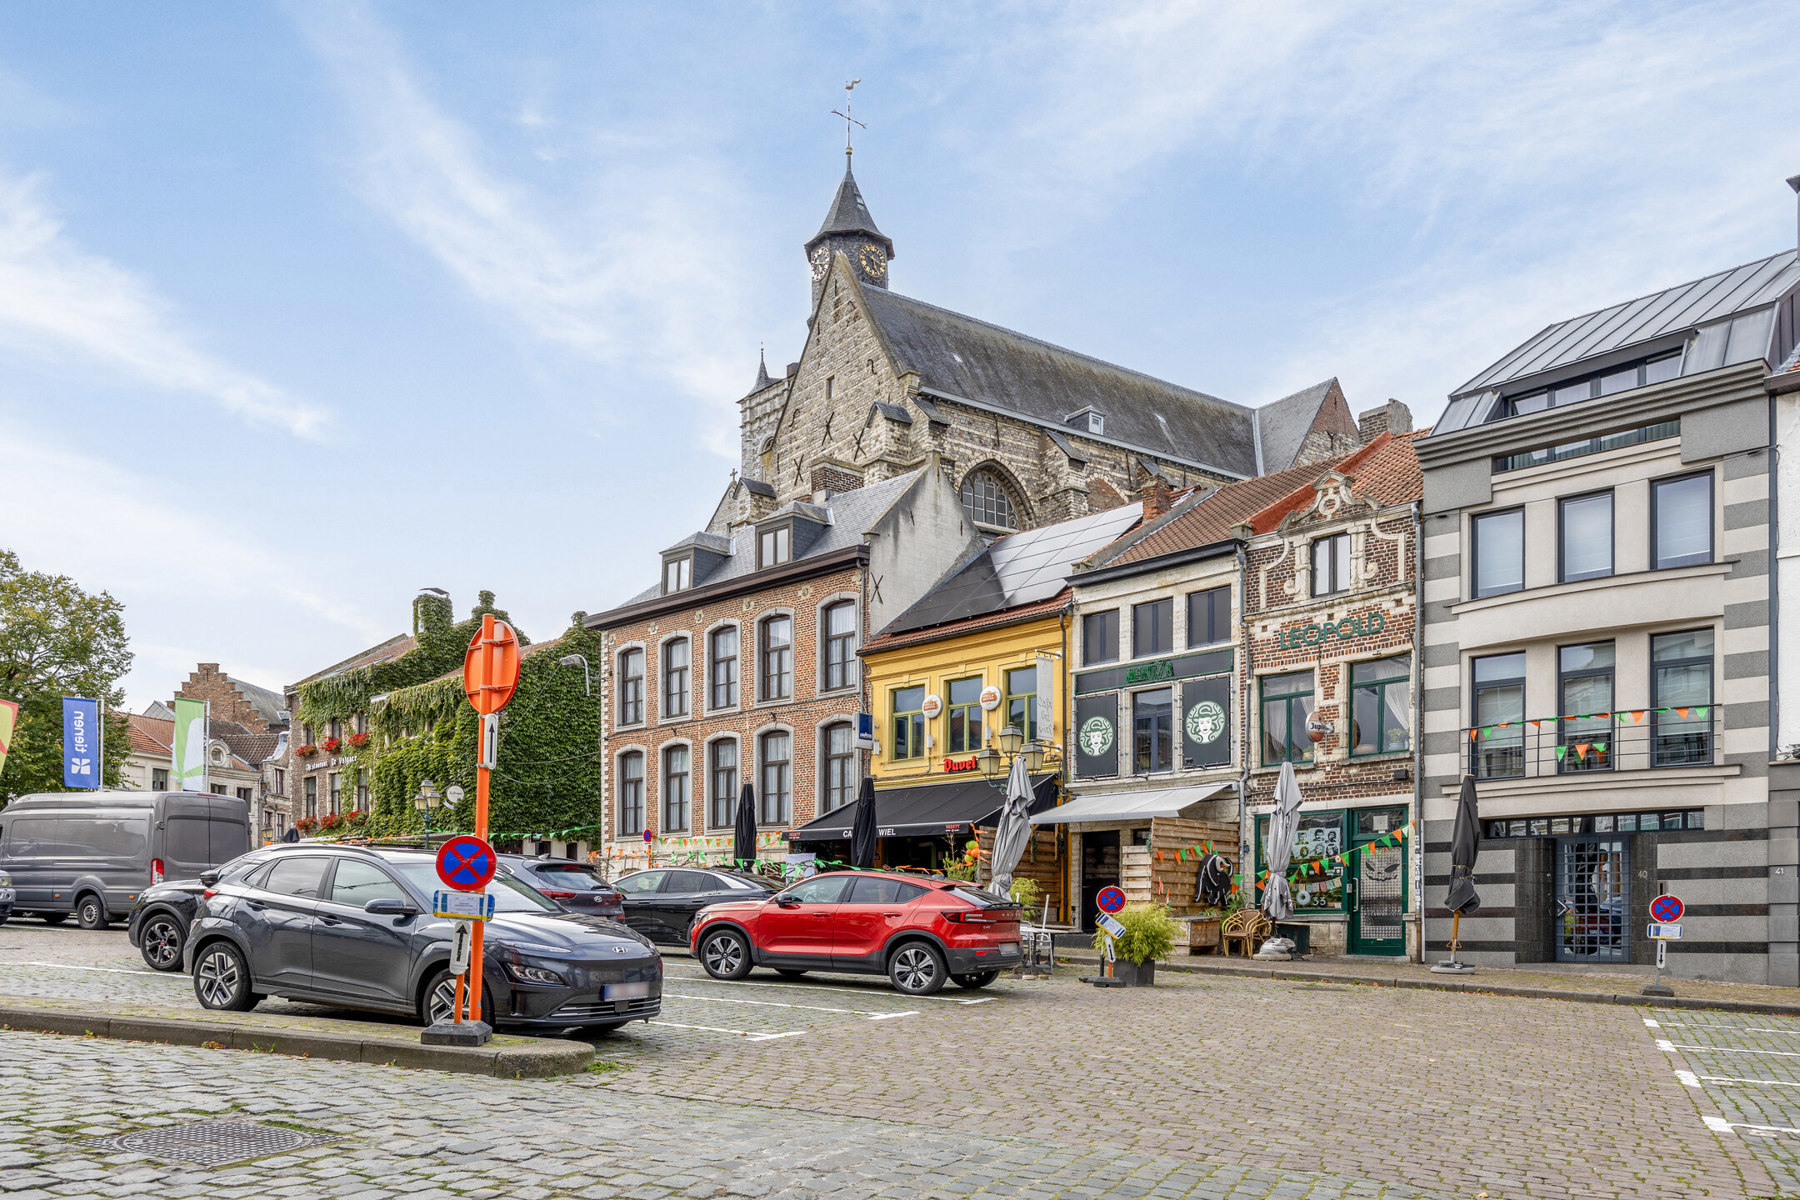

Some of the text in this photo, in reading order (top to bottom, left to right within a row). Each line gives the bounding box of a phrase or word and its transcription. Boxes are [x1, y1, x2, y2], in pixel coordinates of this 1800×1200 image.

[1280, 613, 1385, 649] LEOPOLD
[943, 755, 976, 772] Duvel
[878, 828, 896, 836] WIEL
[1638, 870, 1648, 879] 40
[1312, 897, 1326, 906] 33
